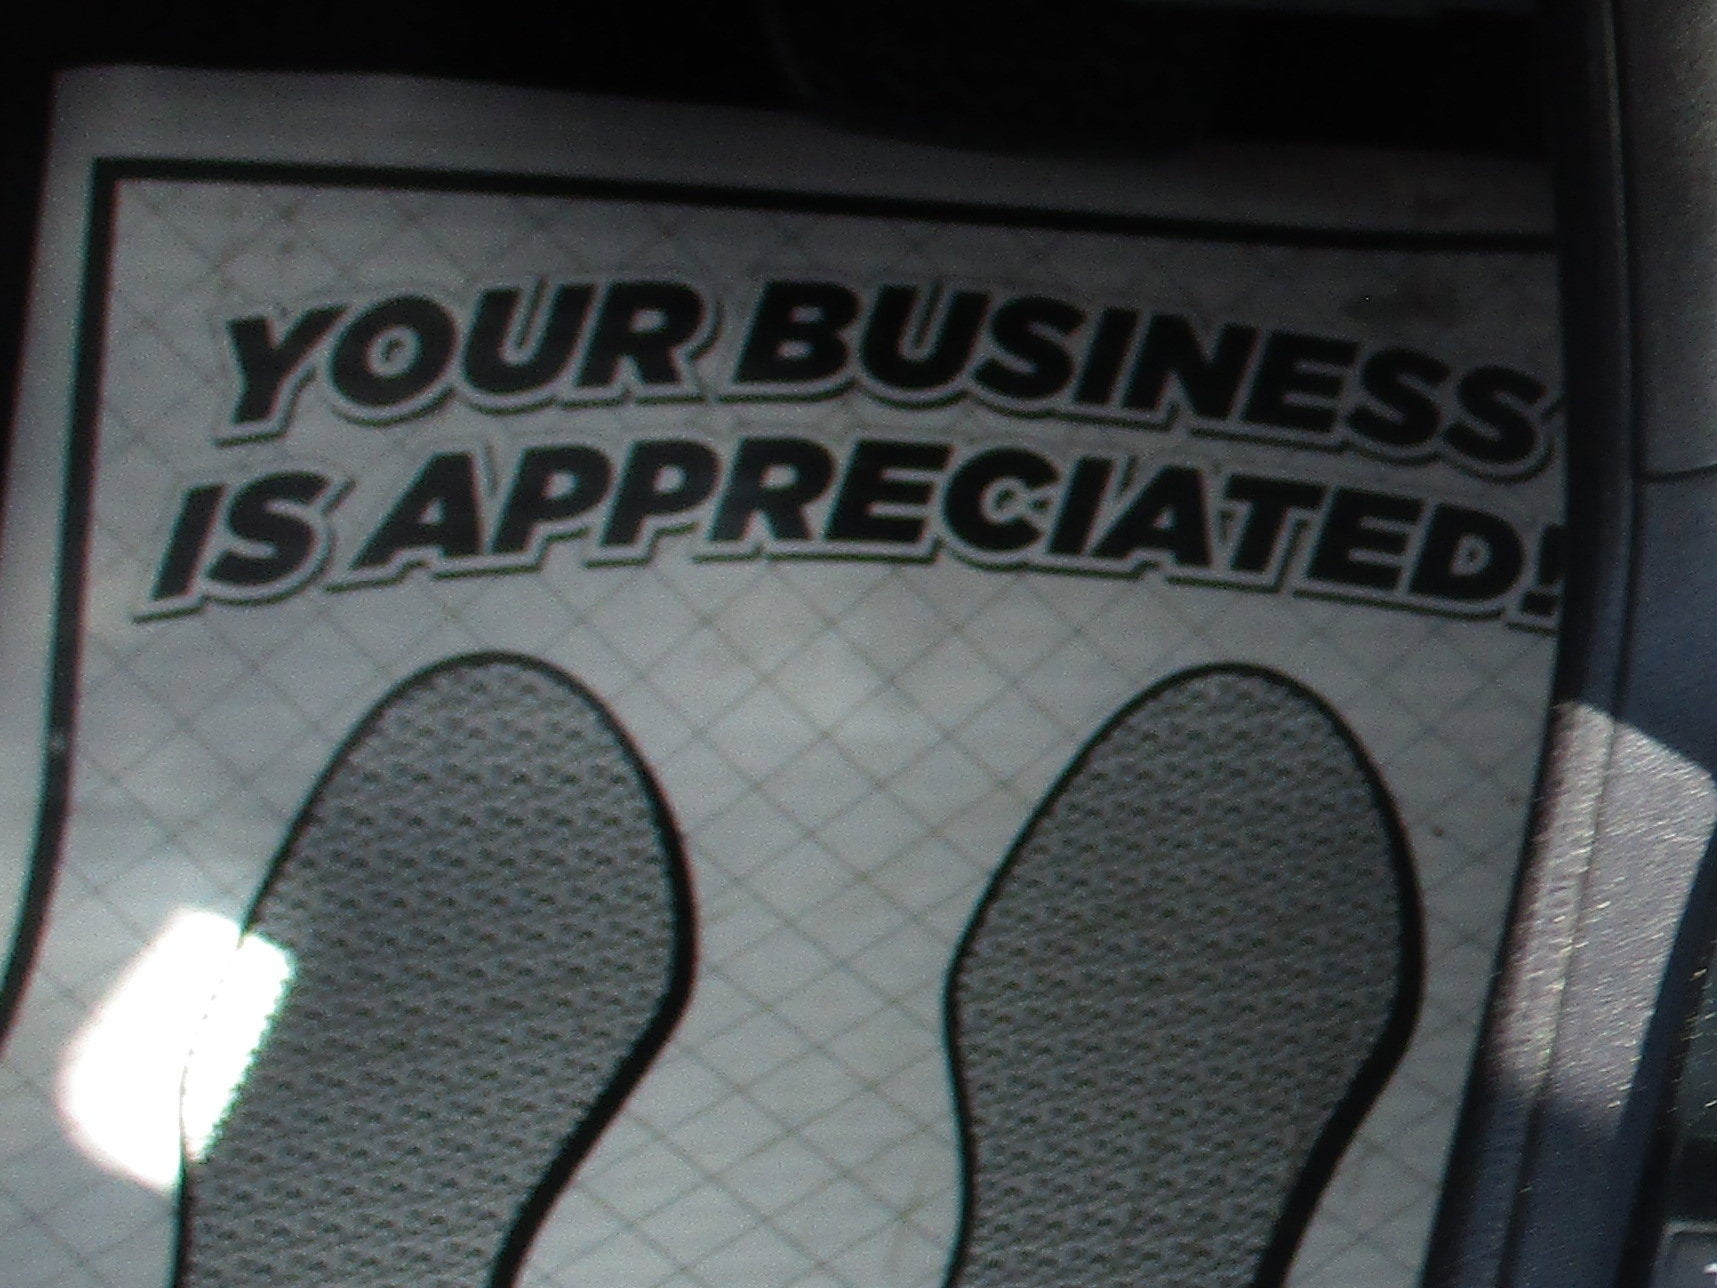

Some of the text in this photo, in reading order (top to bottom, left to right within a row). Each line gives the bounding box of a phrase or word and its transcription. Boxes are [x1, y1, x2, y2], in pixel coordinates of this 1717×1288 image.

[222, 278, 1554, 476] YOUR BUSINESS
[144, 434, 1564, 622] IS APPRECIATED!
